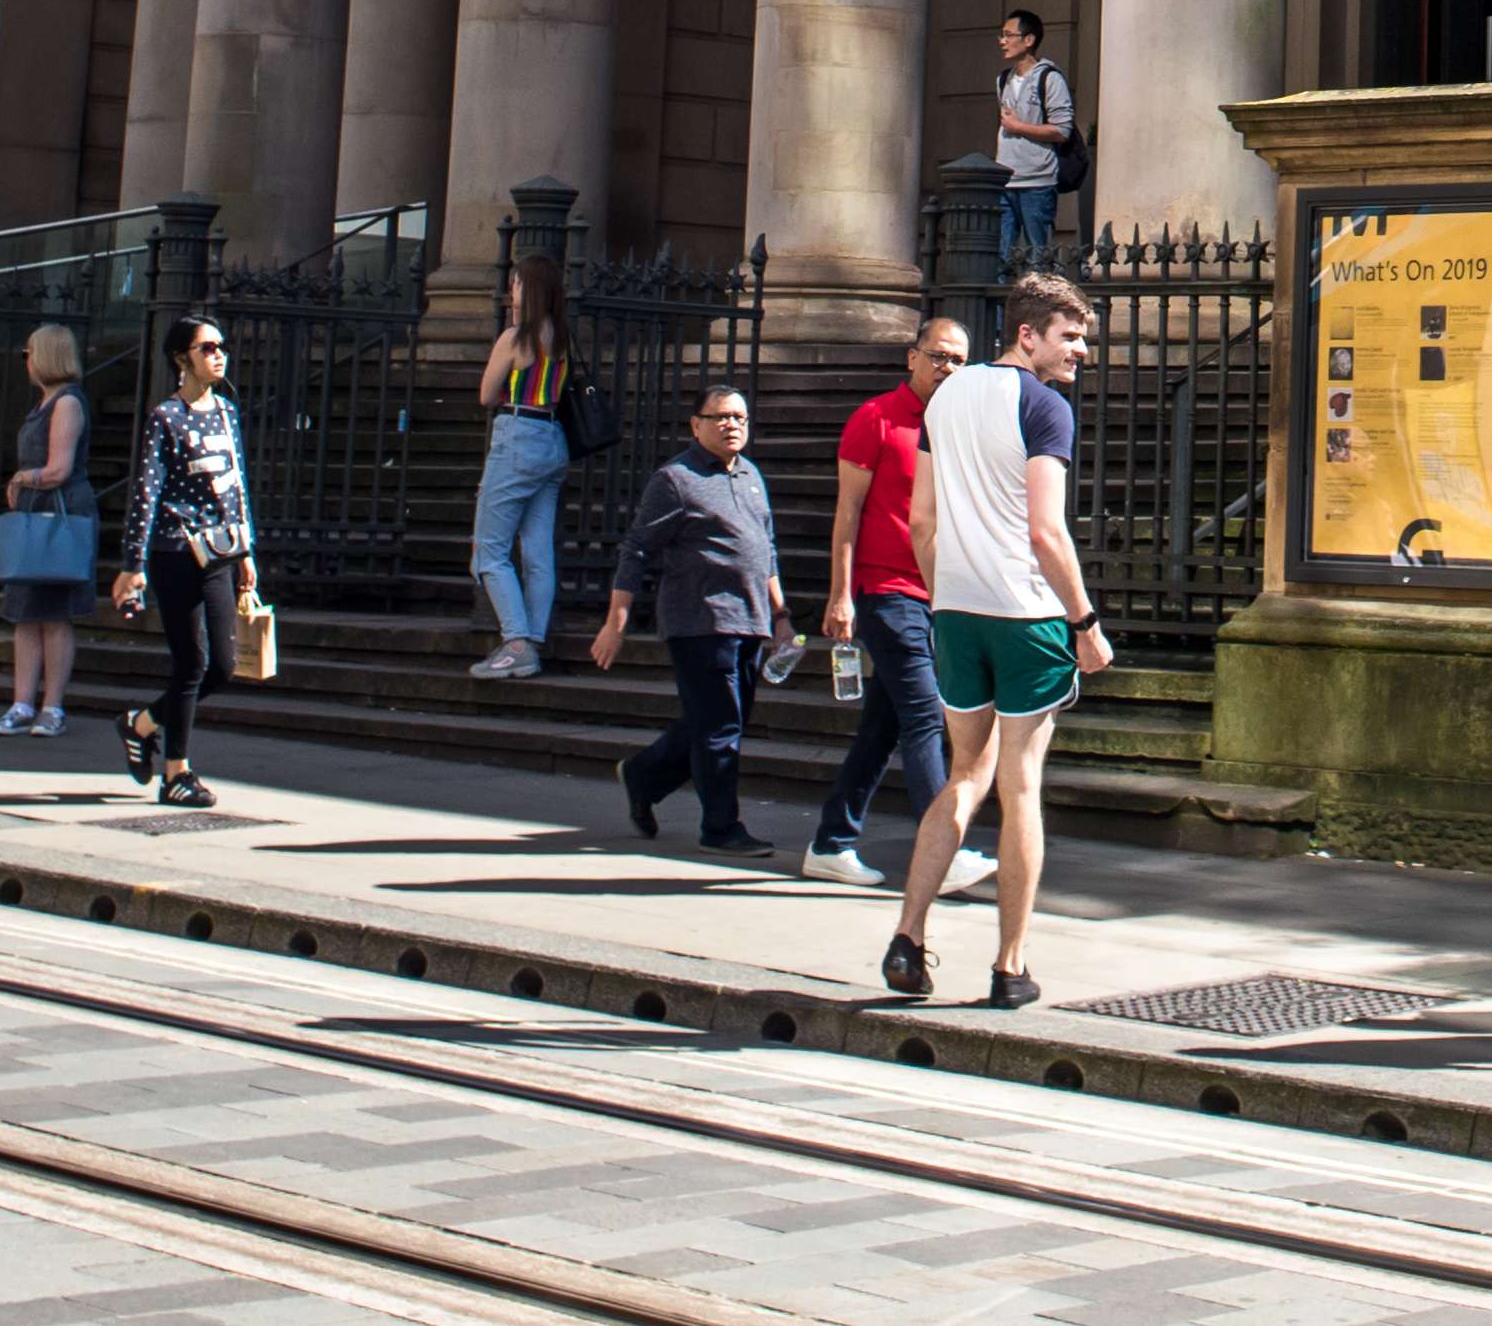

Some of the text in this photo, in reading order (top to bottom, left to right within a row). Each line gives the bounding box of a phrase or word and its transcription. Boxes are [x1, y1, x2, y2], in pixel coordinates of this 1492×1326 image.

[1331, 258, 1488, 283] What's On 2019
